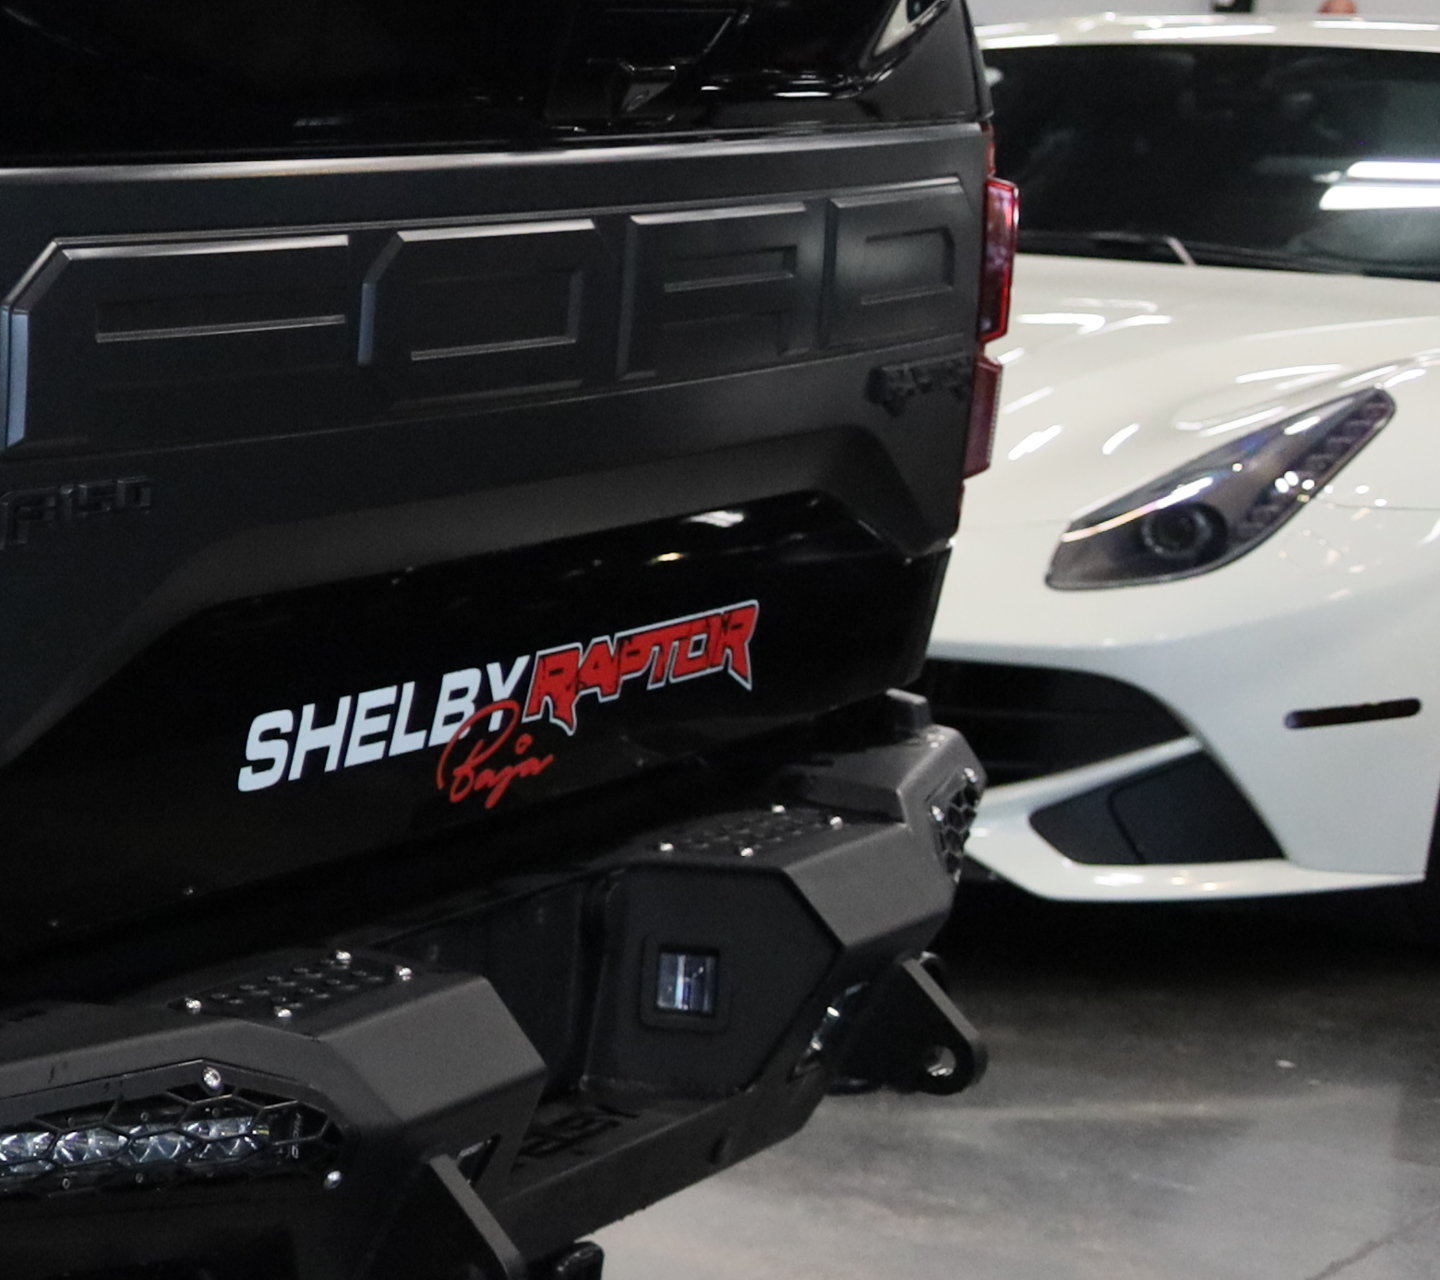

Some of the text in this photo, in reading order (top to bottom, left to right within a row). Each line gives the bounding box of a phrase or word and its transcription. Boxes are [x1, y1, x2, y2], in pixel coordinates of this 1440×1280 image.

[237, 599, 760, 793] SHELBY RAPTOR
[436, 699, 555, 809] Baja
